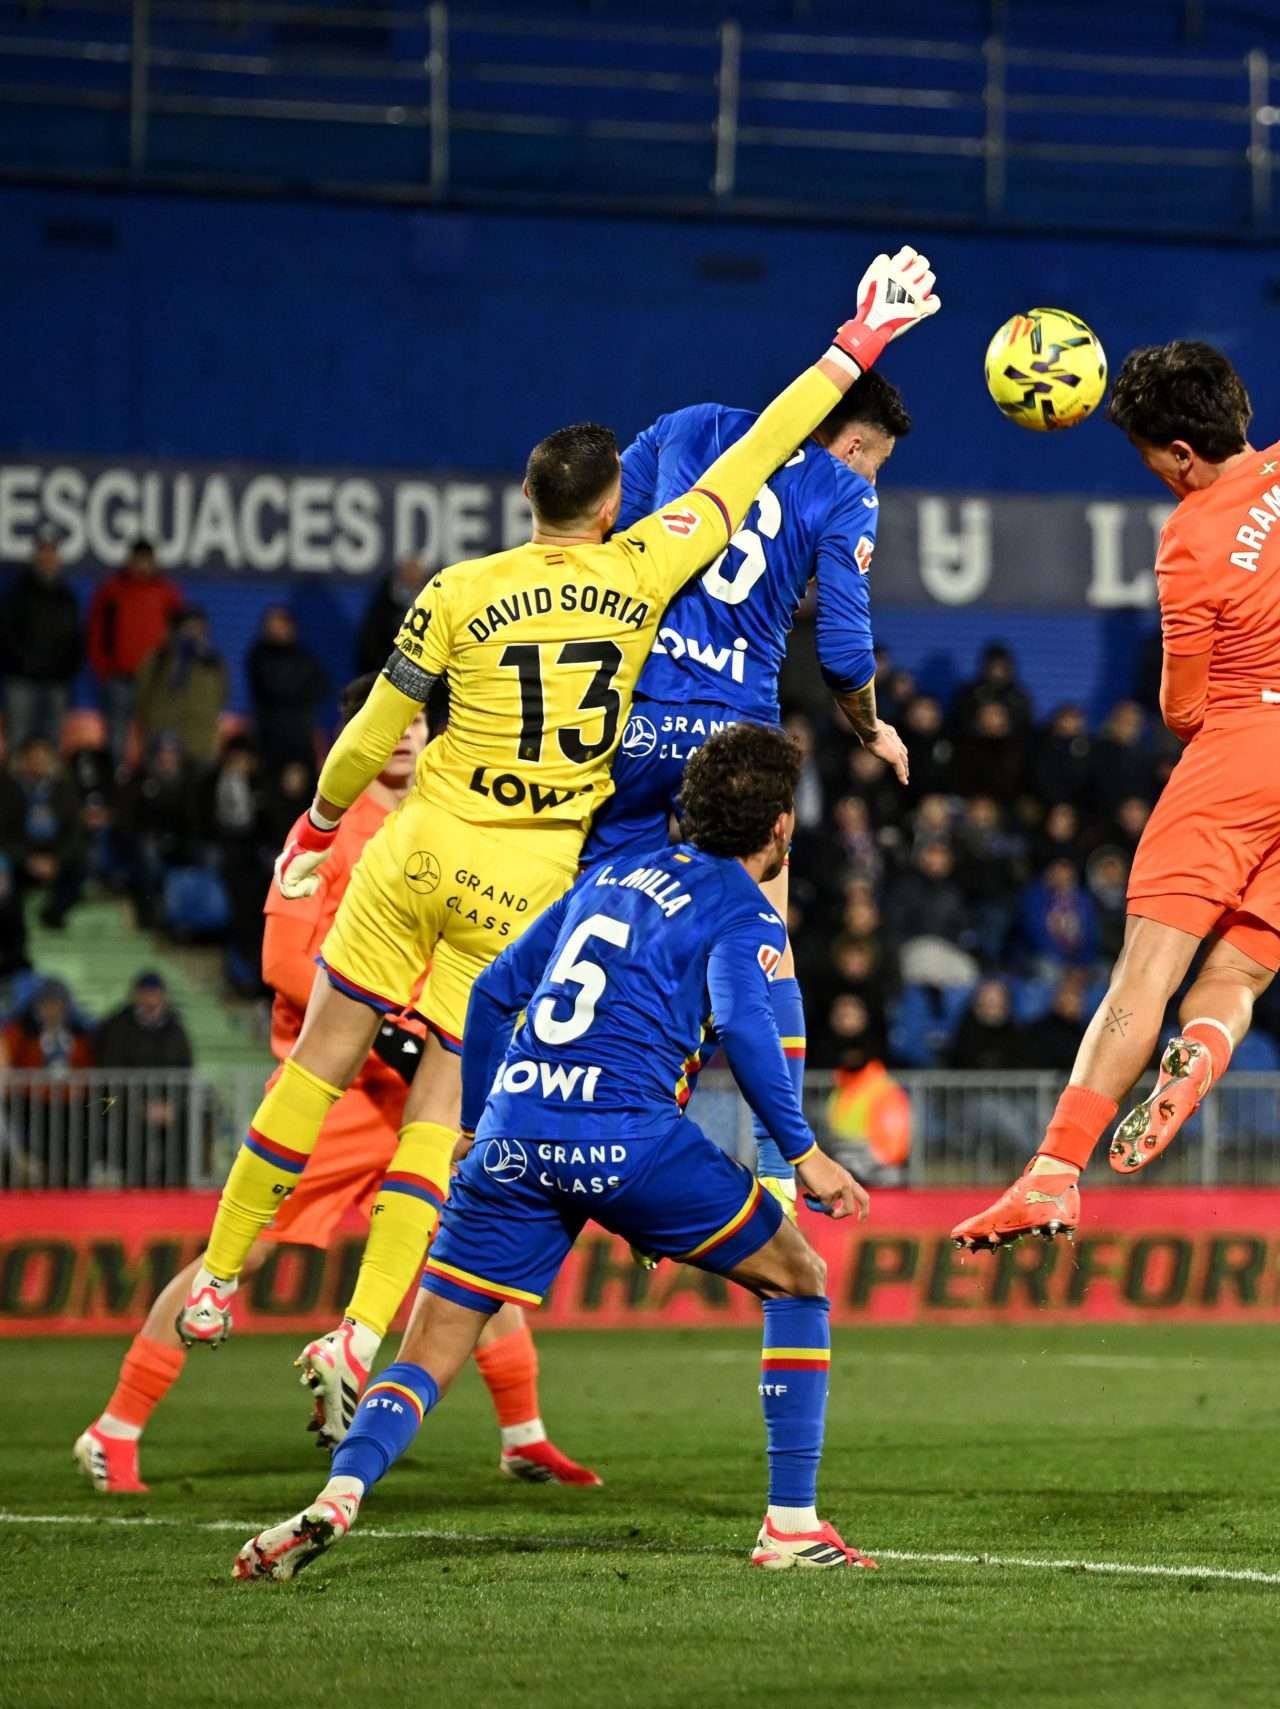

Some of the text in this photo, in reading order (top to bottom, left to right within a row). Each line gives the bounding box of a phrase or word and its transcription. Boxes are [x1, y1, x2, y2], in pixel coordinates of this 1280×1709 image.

[0, 466, 382, 573] ESGUACES
[394, 480, 502, 565] DE
[467, 587, 552, 642] DAVID
[560, 584, 649, 629] SORIA
[500, 641, 623, 763] 13
[446, 896, 512, 936] CLASS
[455, 869, 529, 913] GRAND
[618, 867, 693, 918] MILLA
[533, 913, 630, 1045] 5
[538, 1143, 627, 1165] GRAND
[540, 1171, 621, 1193] CLASS
